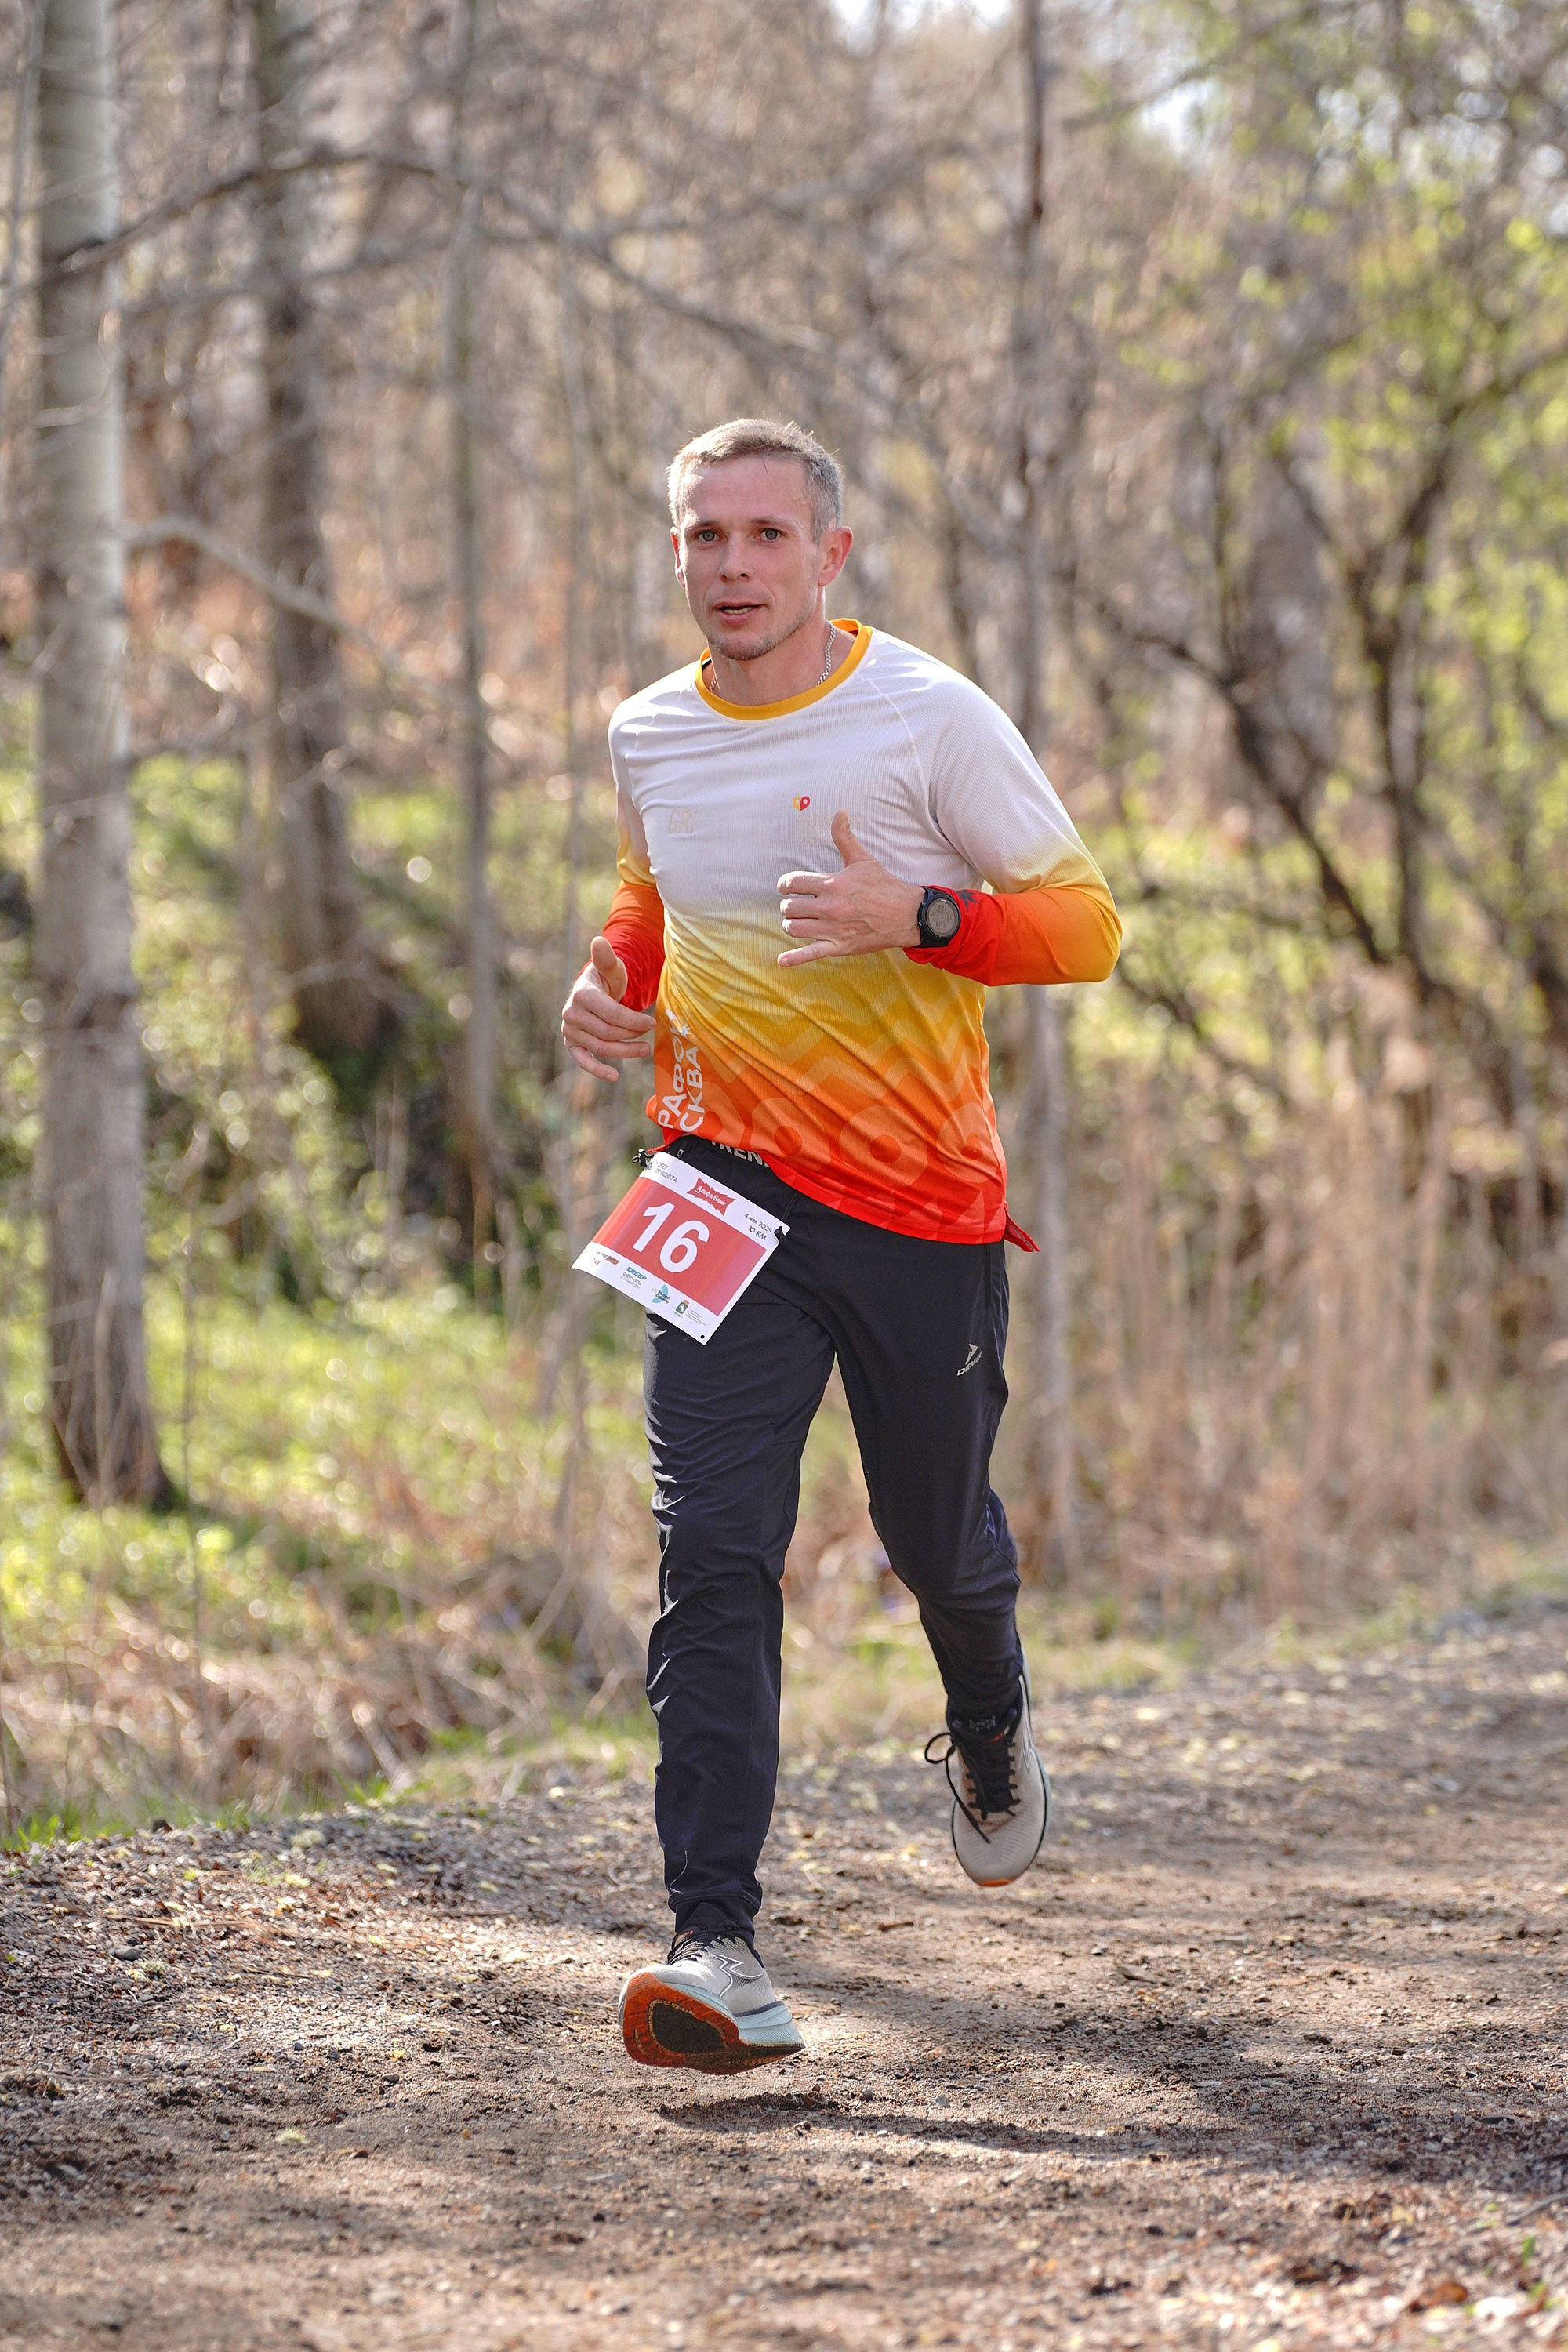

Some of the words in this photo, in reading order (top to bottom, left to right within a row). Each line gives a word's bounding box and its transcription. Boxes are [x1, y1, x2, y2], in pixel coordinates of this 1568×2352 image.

[680, 1046, 706, 1132] СКВА
[695, 1185, 714, 1200] Альфа
[713, 1195, 728, 1207] Банк
[632, 1202, 710, 1273] 16
[757, 1221, 772, 1233] 2025
[626, 1266, 648, 1280] СИБУР
